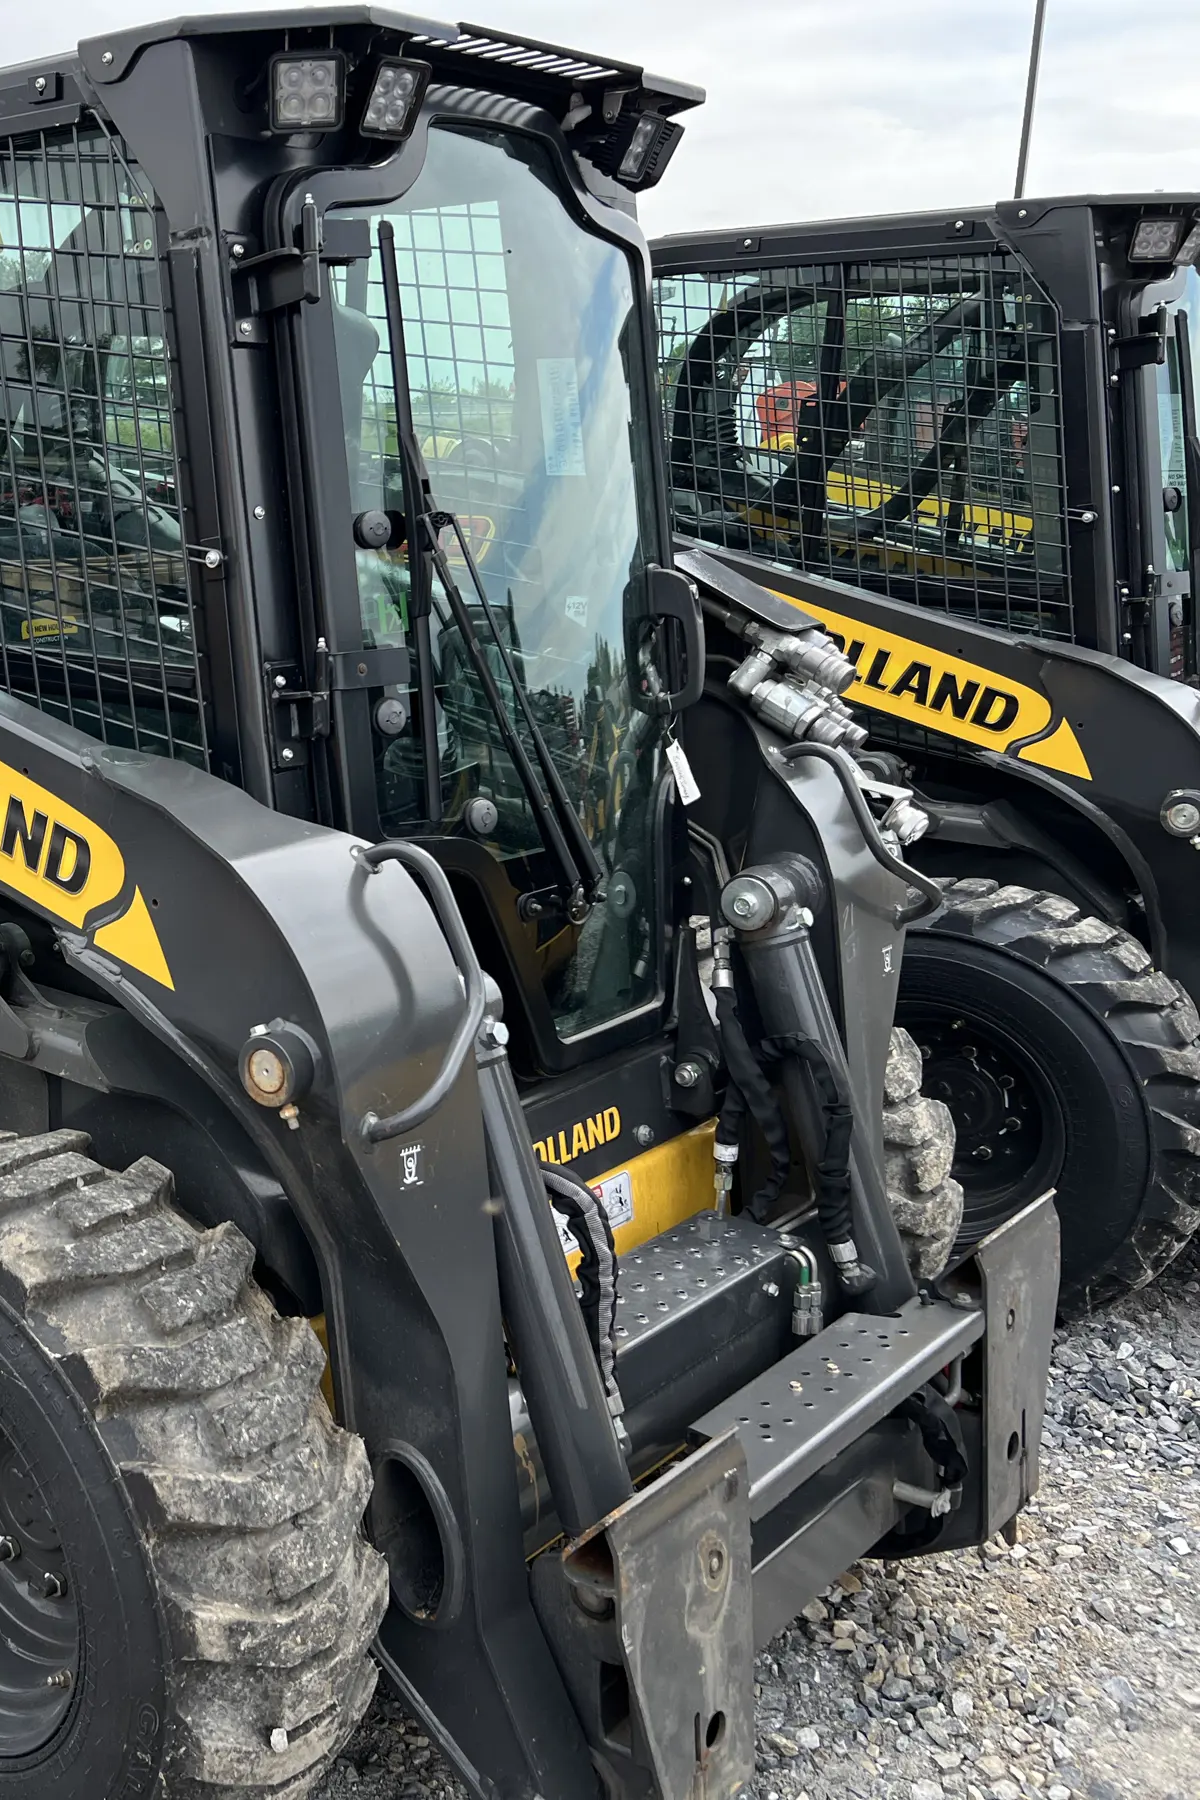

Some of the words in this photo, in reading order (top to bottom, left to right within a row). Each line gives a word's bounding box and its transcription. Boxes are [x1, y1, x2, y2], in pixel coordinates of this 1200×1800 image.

[34, 624, 48, 633] NEW
[825, 630, 1020, 733] LLAND
[532, 1106, 621, 1165] OLLAND
